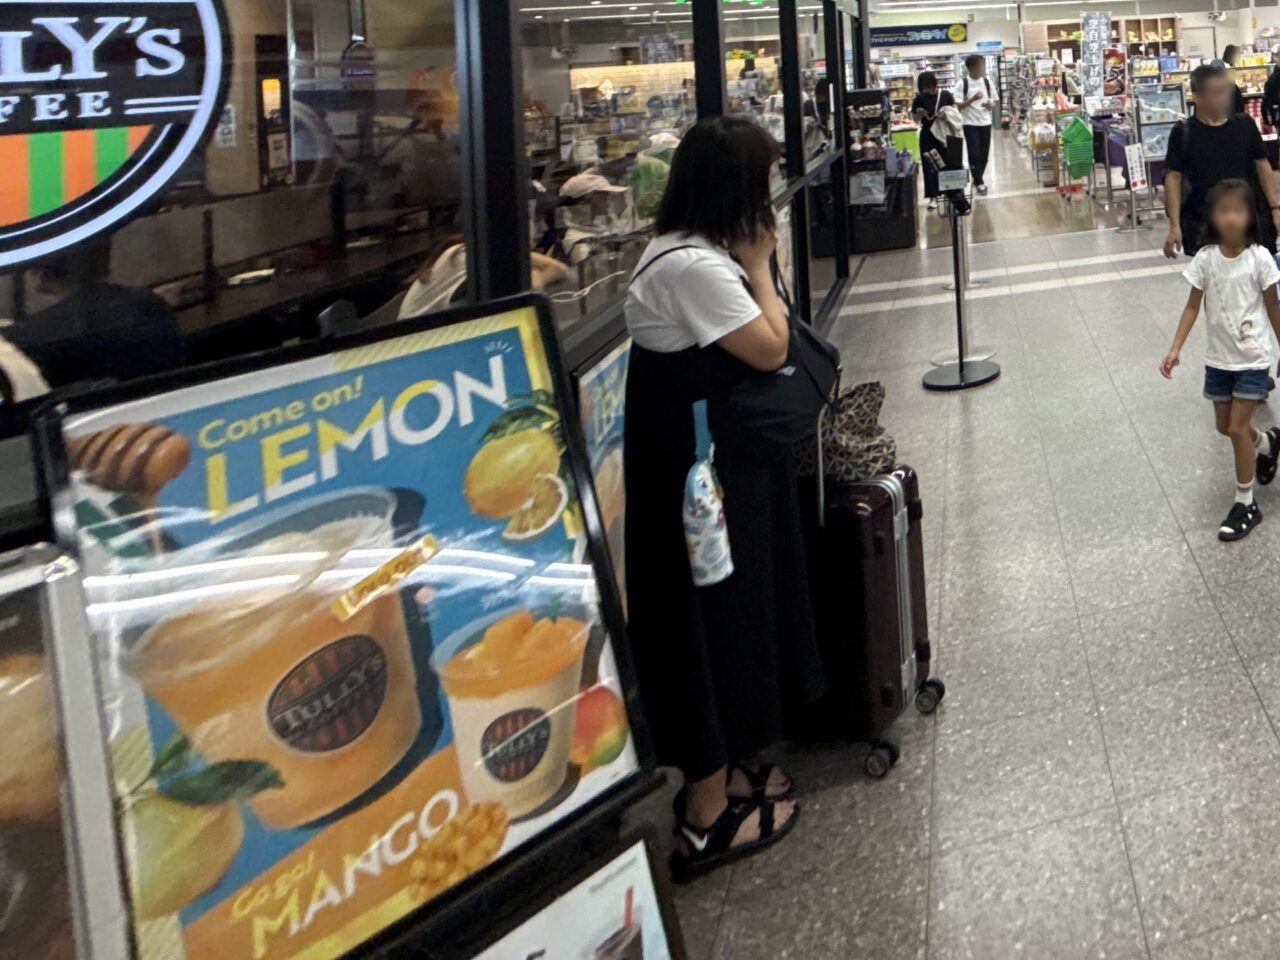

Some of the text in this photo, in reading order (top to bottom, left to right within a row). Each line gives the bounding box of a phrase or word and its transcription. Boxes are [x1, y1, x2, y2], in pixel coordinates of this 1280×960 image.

[198, 374, 364, 449] Come on!
[206, 354, 508, 524] LEMON
[253, 789, 458, 959] MANGO
